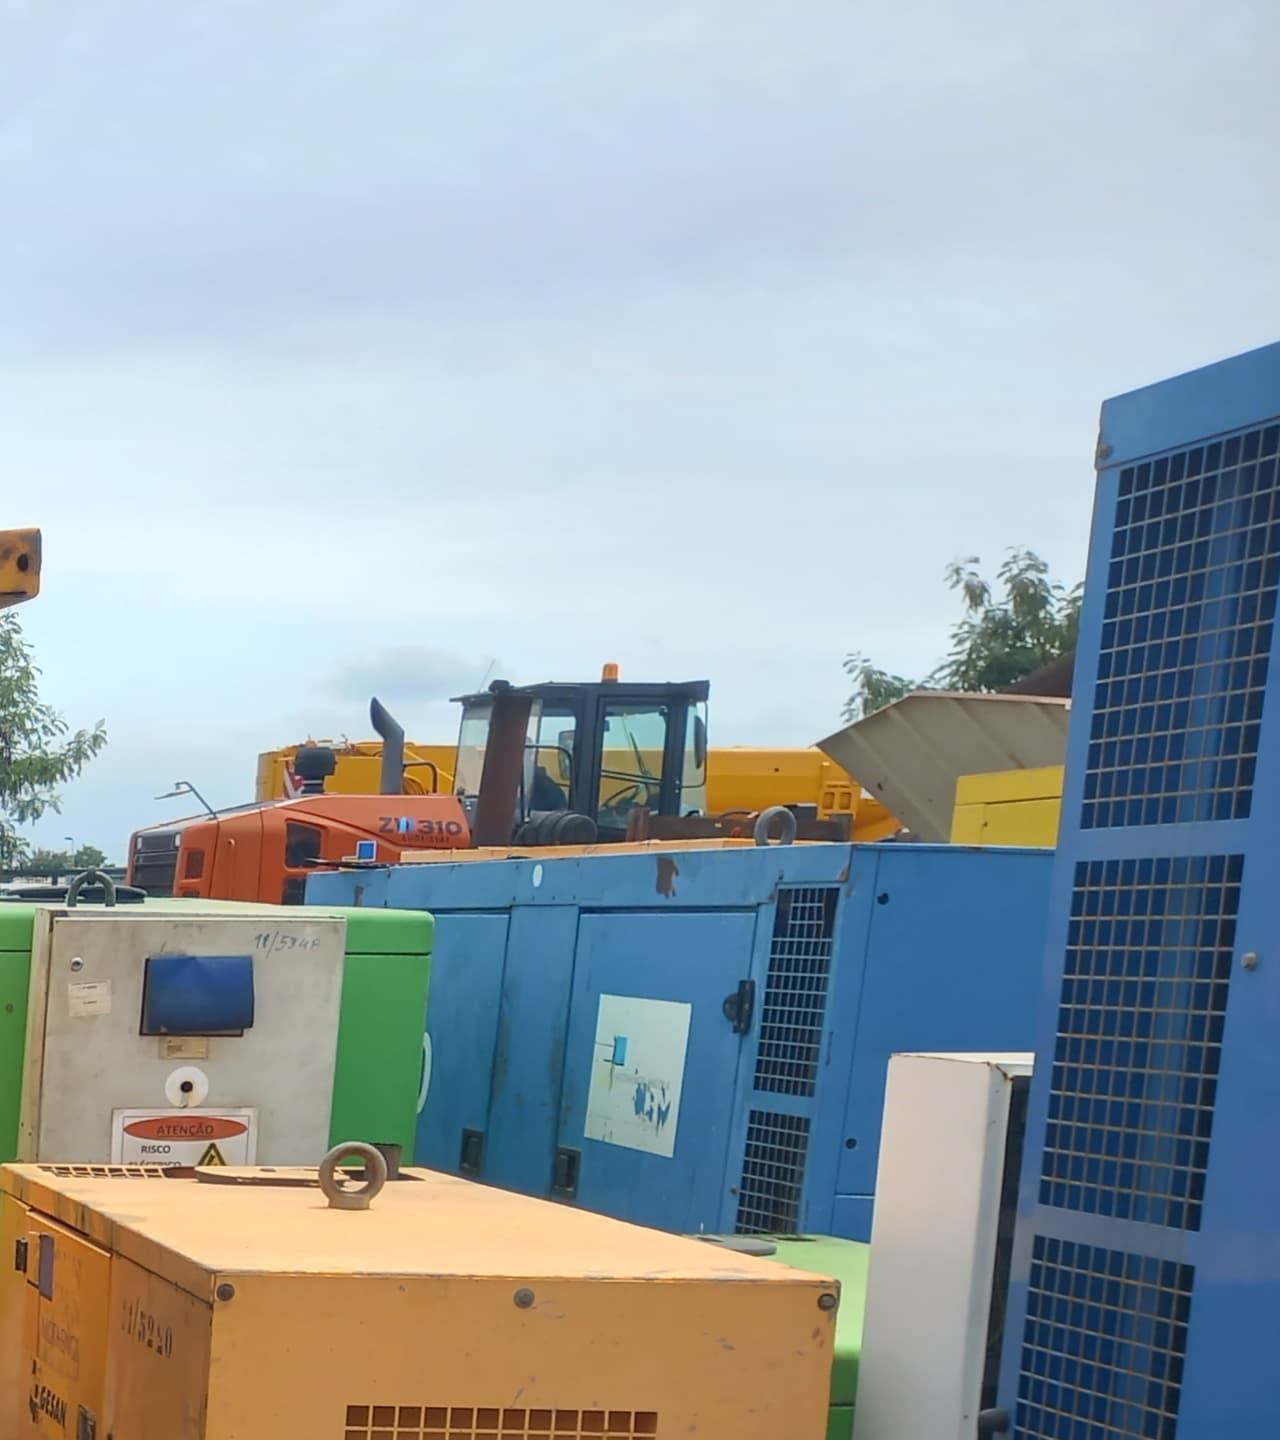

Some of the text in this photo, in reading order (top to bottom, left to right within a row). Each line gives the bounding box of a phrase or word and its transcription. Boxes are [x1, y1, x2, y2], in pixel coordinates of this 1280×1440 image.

[156, 1122, 215, 1137] ATENÇÃO
[140, 1144, 171, 1154] RISCO
[40, 1385, 67, 1429] GESAN
